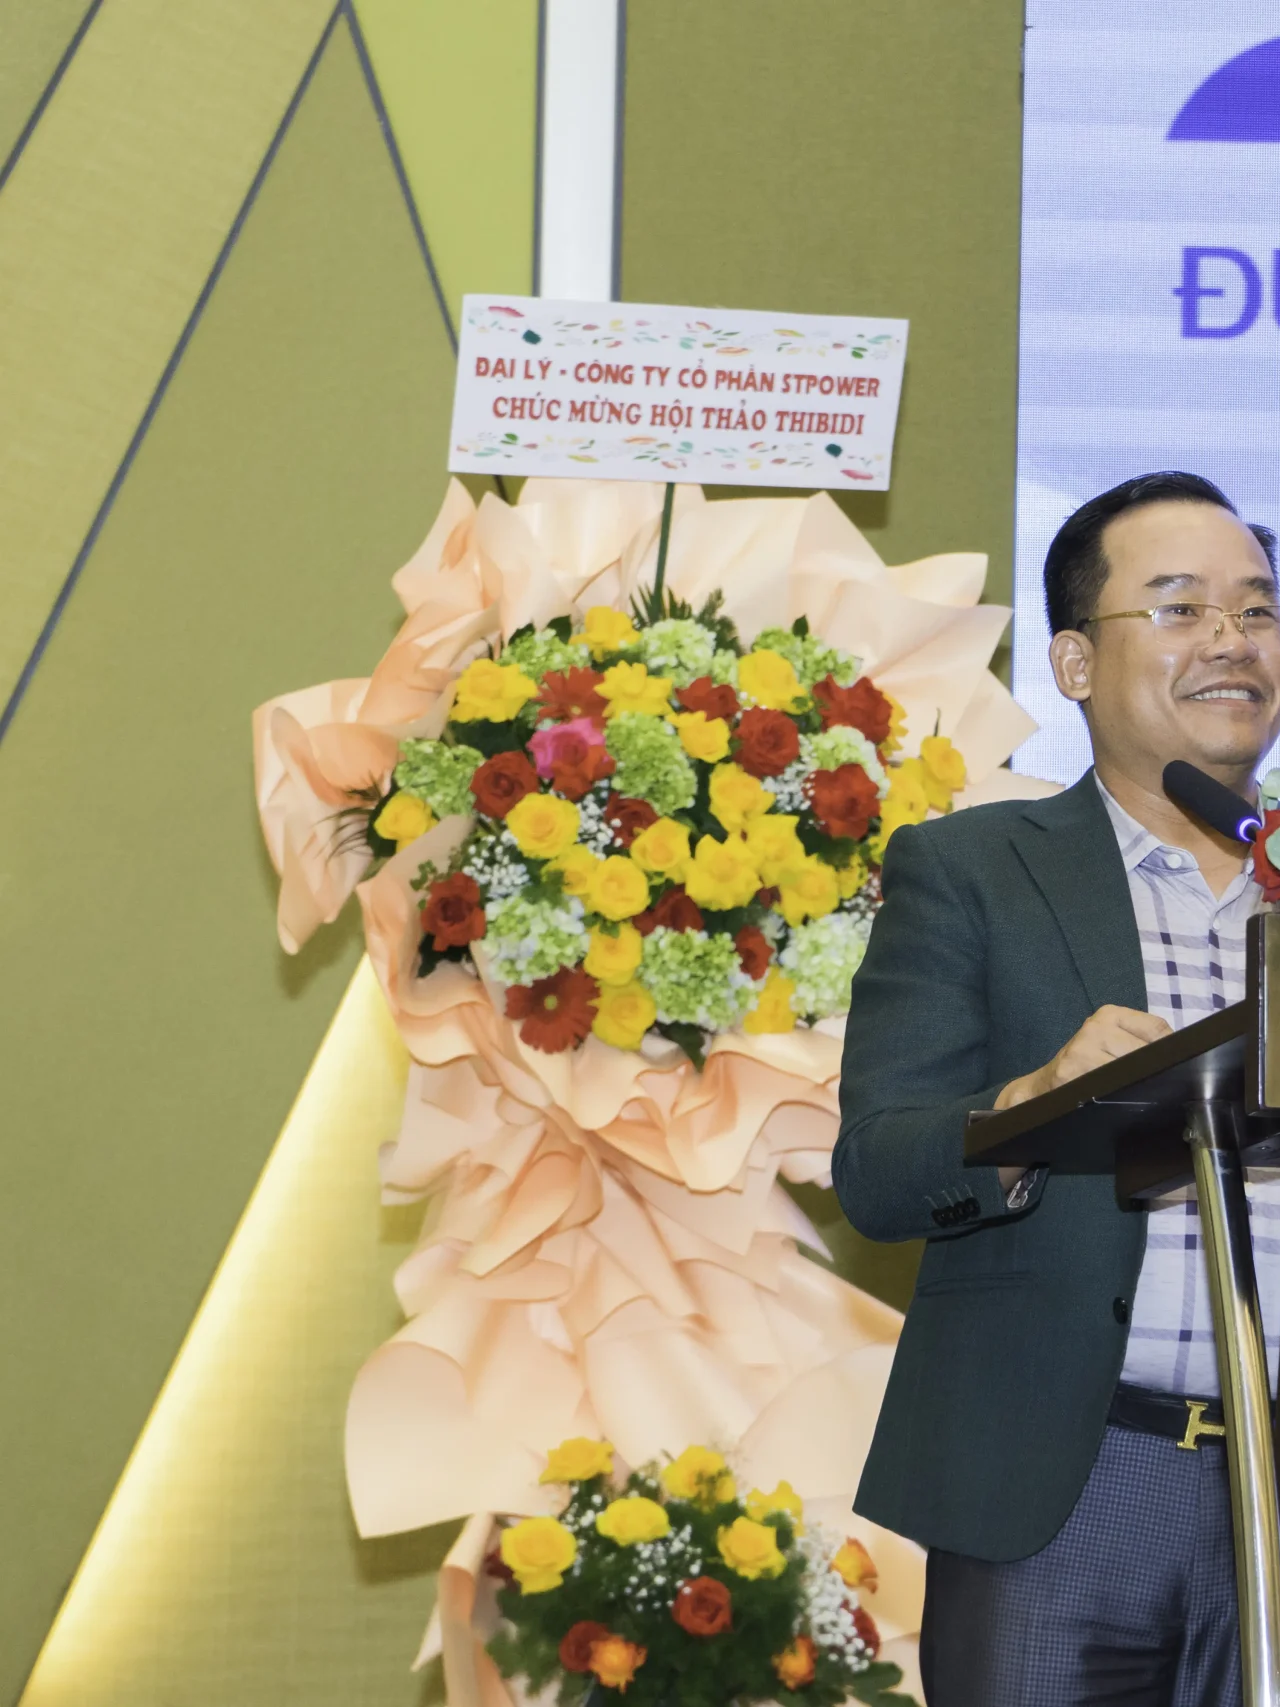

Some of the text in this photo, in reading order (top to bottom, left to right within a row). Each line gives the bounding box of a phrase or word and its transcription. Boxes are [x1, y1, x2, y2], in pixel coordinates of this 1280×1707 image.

[475, 356, 516, 382] ĐẠI
[574, 358, 635, 386] CÔNG
[642, 365, 671, 387] TY
[677, 358, 708, 389] CỔ
[781, 372, 880, 398] STPOWER
[492, 390, 865, 435] CHÚC MỪNG HỘI THẢO THIBIDI
